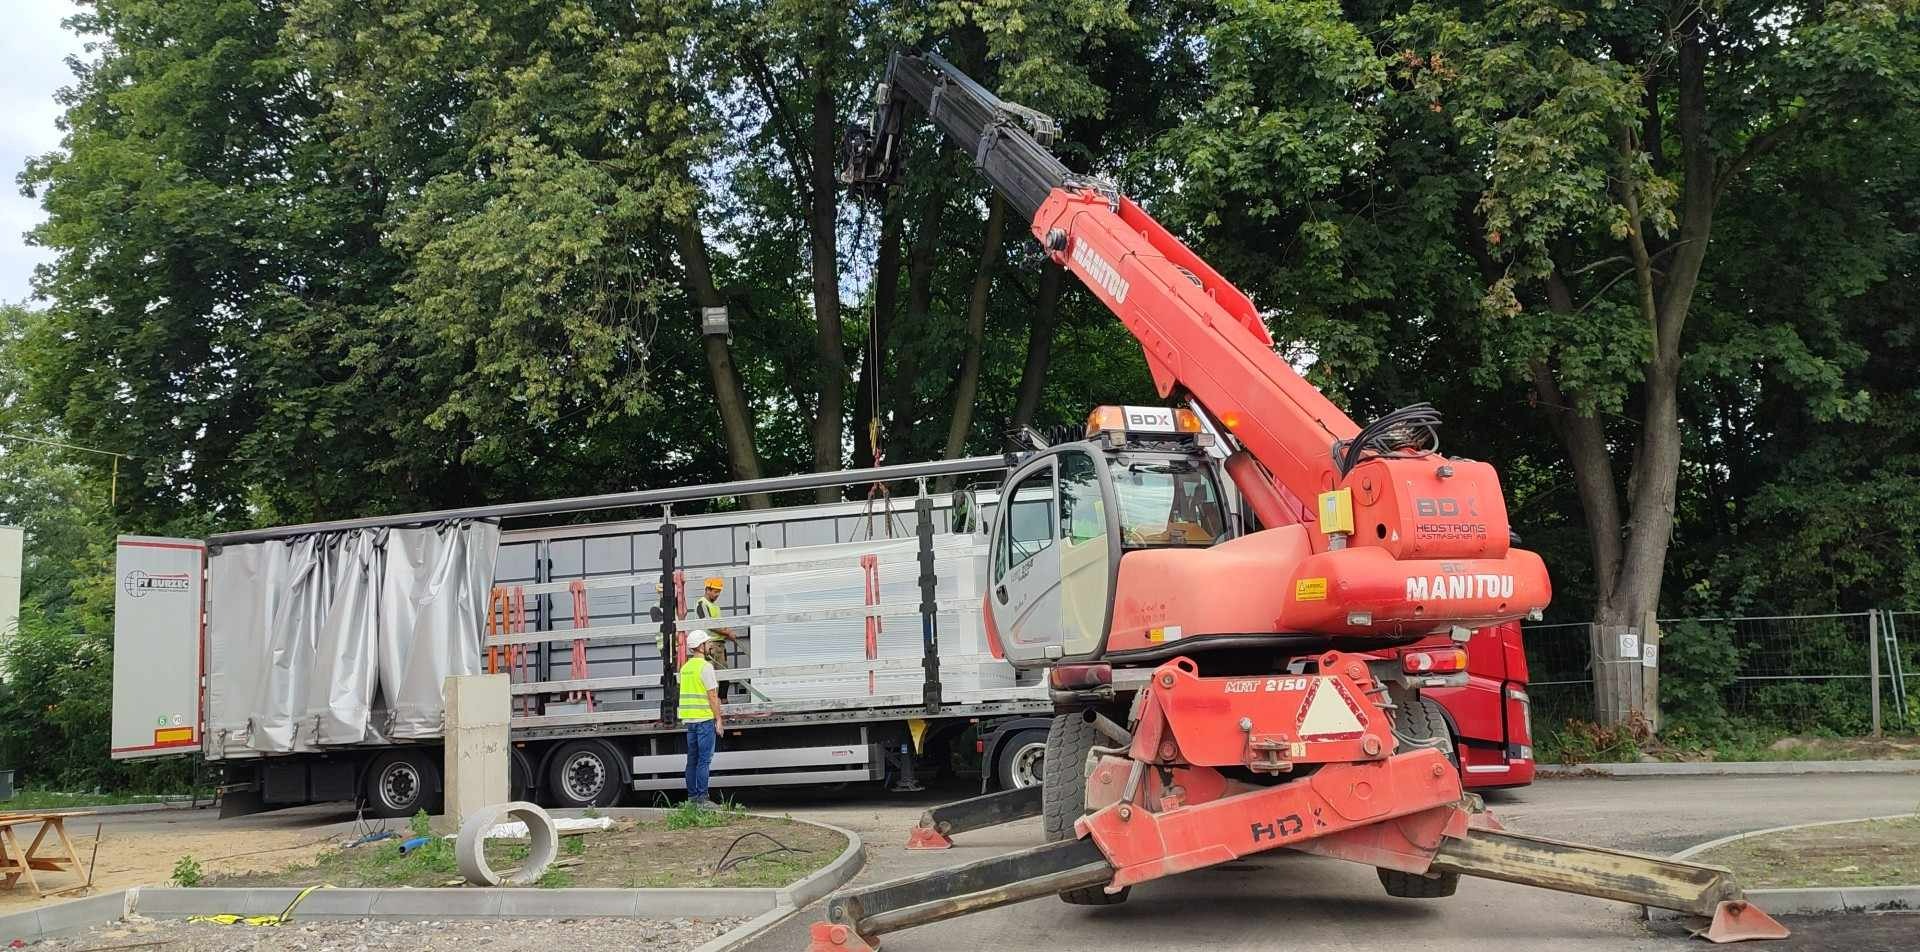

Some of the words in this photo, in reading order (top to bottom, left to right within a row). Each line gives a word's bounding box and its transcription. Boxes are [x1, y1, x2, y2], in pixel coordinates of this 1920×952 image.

[1072, 236, 1130, 304] MANITOU
[1130, 414, 1170, 426] BDX
[1406, 574, 1515, 602] MANITOU
[1224, 680, 1261, 693] MRT
[1264, 678, 1307, 692] 2150
